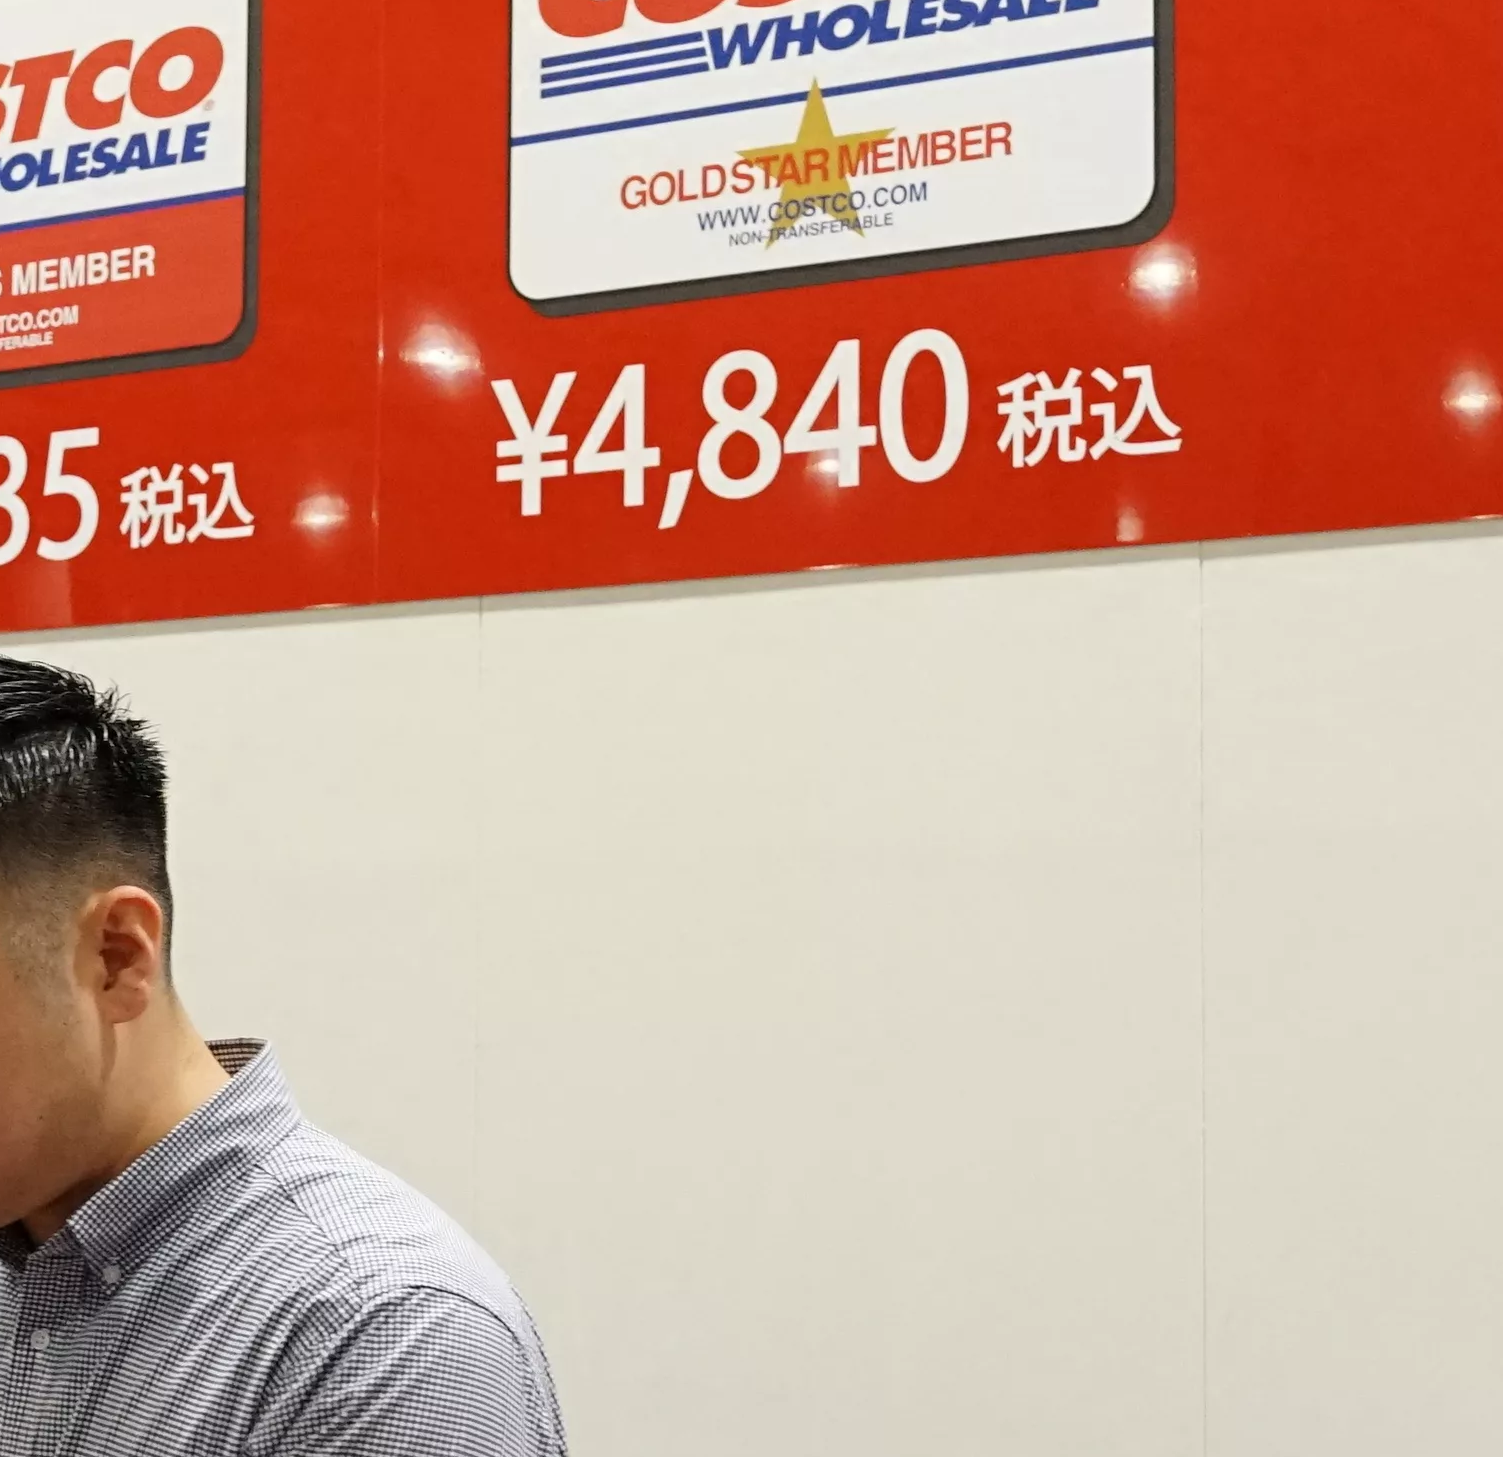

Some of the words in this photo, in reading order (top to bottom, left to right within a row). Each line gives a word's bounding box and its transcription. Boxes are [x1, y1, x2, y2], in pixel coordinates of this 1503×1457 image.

[837, 121, 1013, 179] MEMBER
[697, 181, 929, 232] WWW.COSTCO.COM
[728, 212, 894, 248] NON-TRANSFERABLE
[11, 244, 156, 297] MEMBER
[491, 328, 970, 530] ¥4,840
[997, 365, 1183, 469] 税込
[120, 461, 256, 550] 税込
